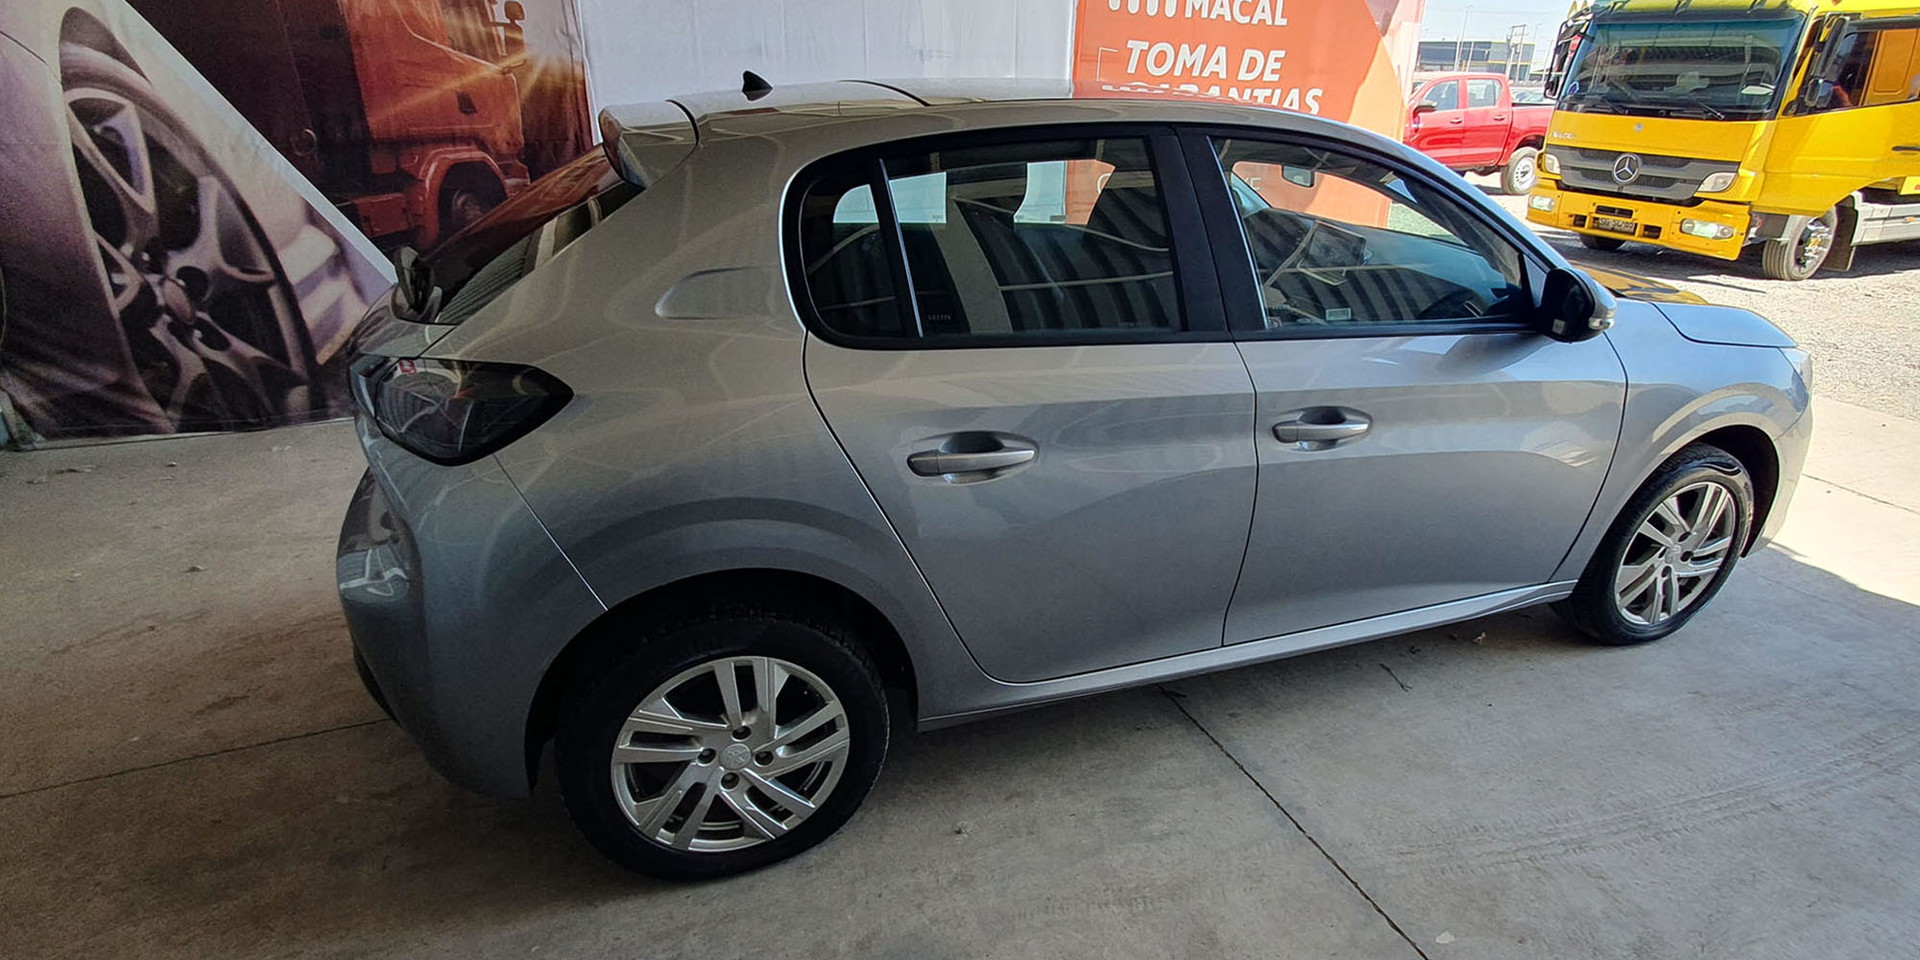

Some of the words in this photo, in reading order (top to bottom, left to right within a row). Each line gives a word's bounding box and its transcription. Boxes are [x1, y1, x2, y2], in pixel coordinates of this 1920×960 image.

[1185, 0, 1288, 26] MACAL
[1126, 39, 1227, 79] TOMA
[1237, 48, 1286, 82] DE
